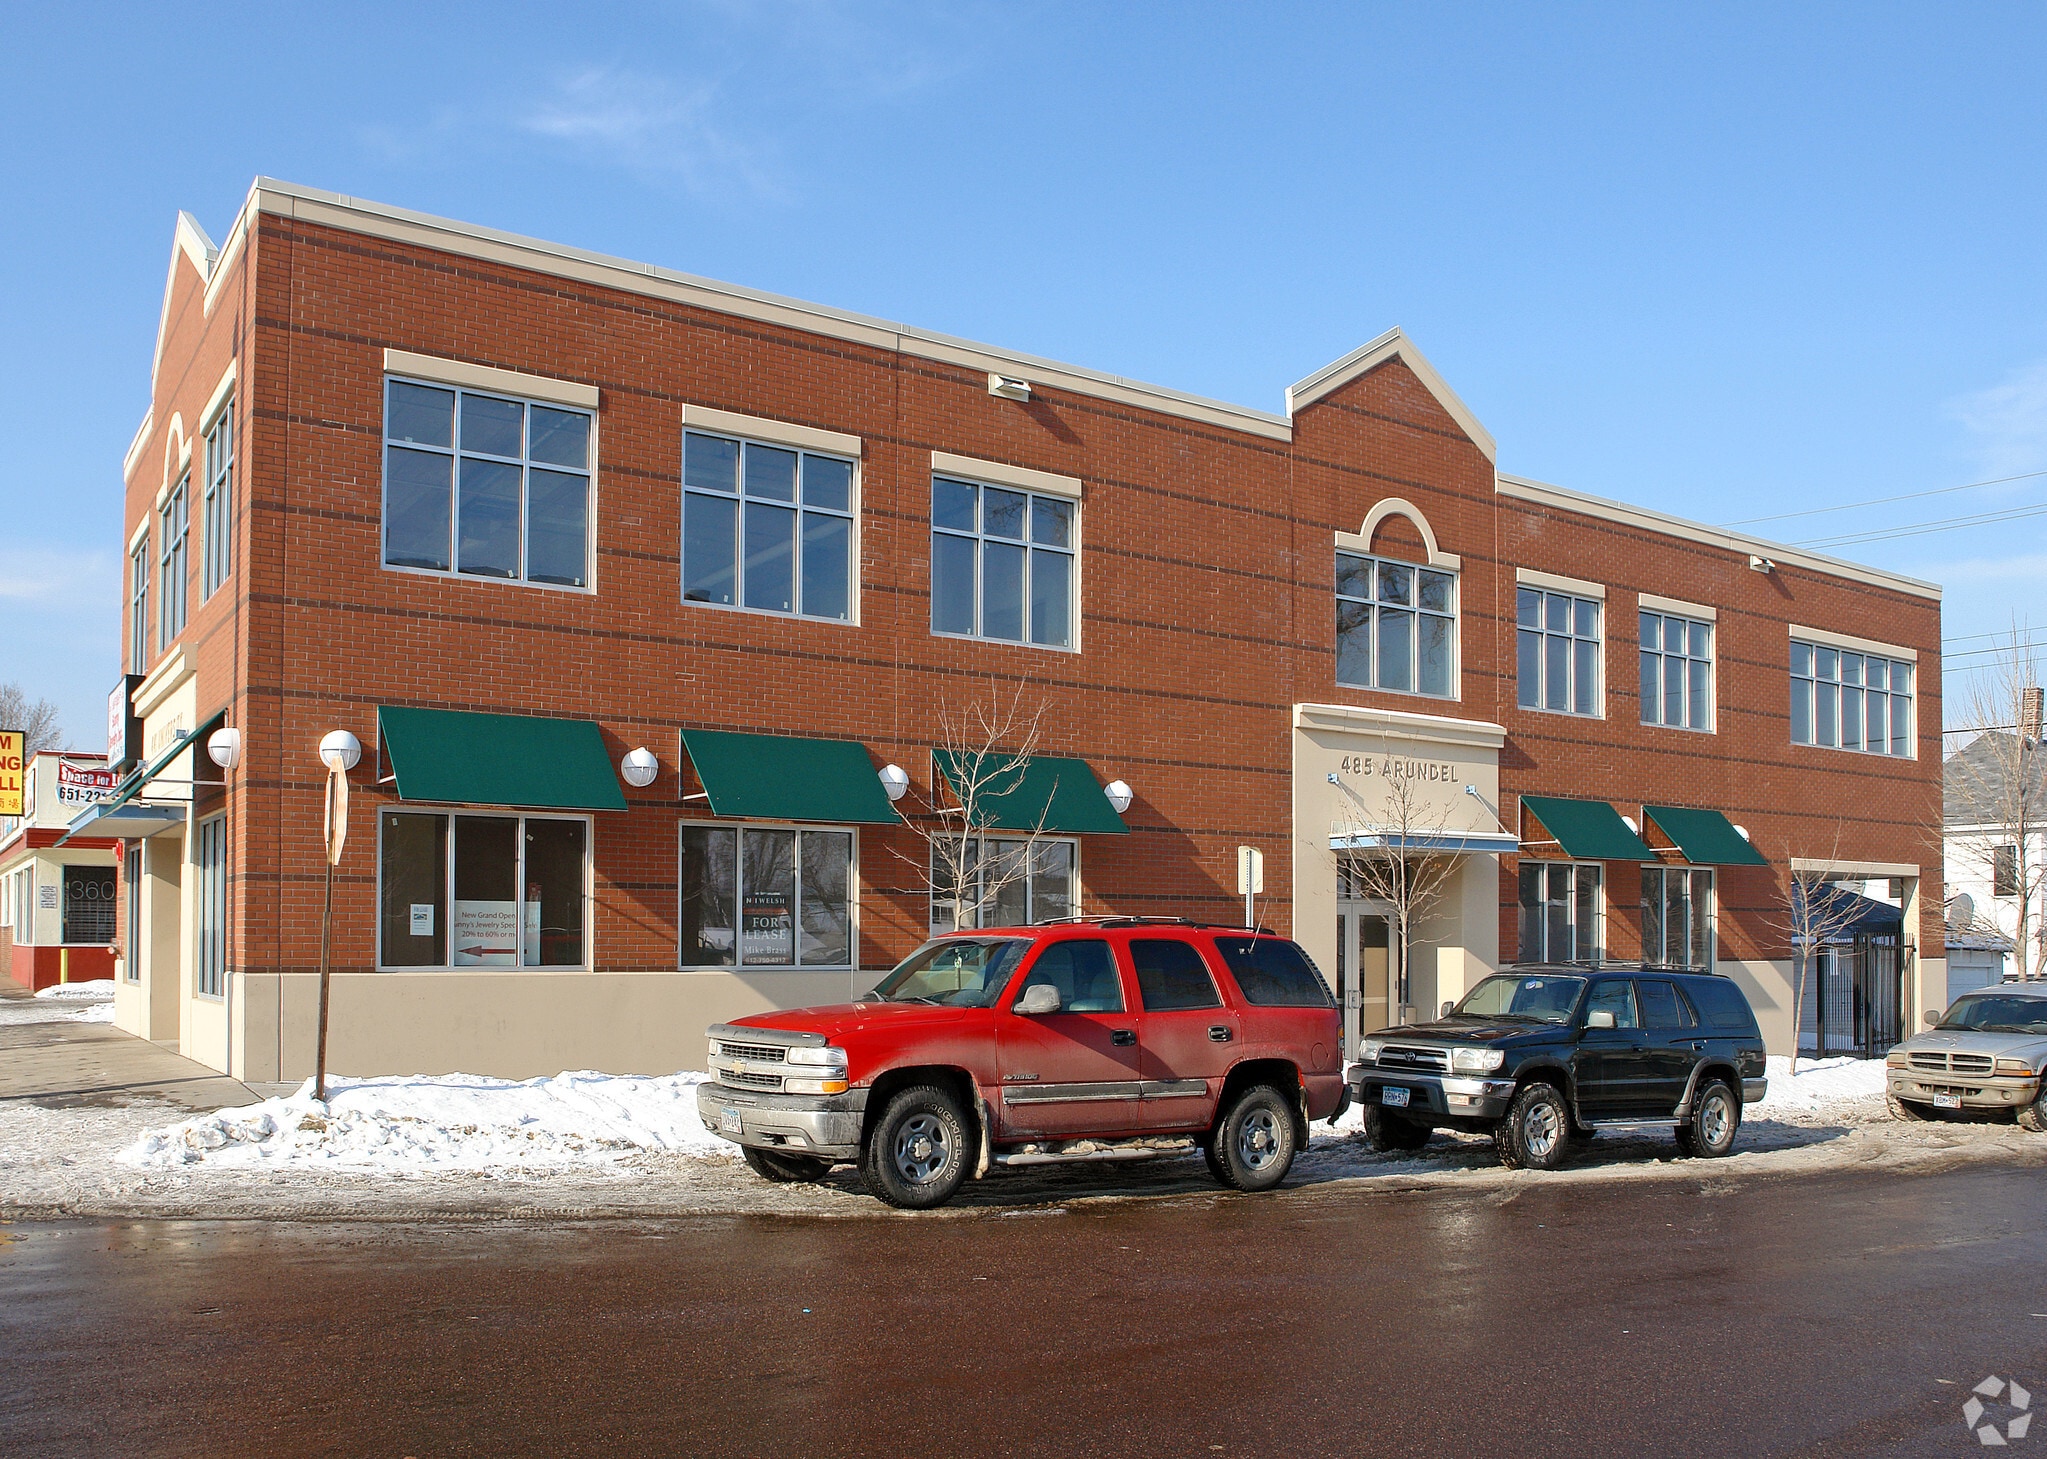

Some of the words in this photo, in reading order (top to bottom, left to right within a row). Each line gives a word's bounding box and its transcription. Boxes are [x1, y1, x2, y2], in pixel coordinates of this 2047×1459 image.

[1341, 755, 1373, 775] 485
[1382, 759, 1459, 783] ARUNDEL
[61, 765, 95, 785] Space
[96, 774, 110, 786] for
[71, 881, 115, 900] 360
[477, 911, 498, 919] Grand
[498, 911, 516, 920] Open
[454, 921, 475, 929] unny's
[475, 921, 499, 930] Jewelry
[752, 917, 779, 928] FOR
[461, 930, 476, 938] 20%
[485, 930, 499, 938] 60%
[745, 929, 787, 940] LEASE
[744, 945, 764, 954] Mike
